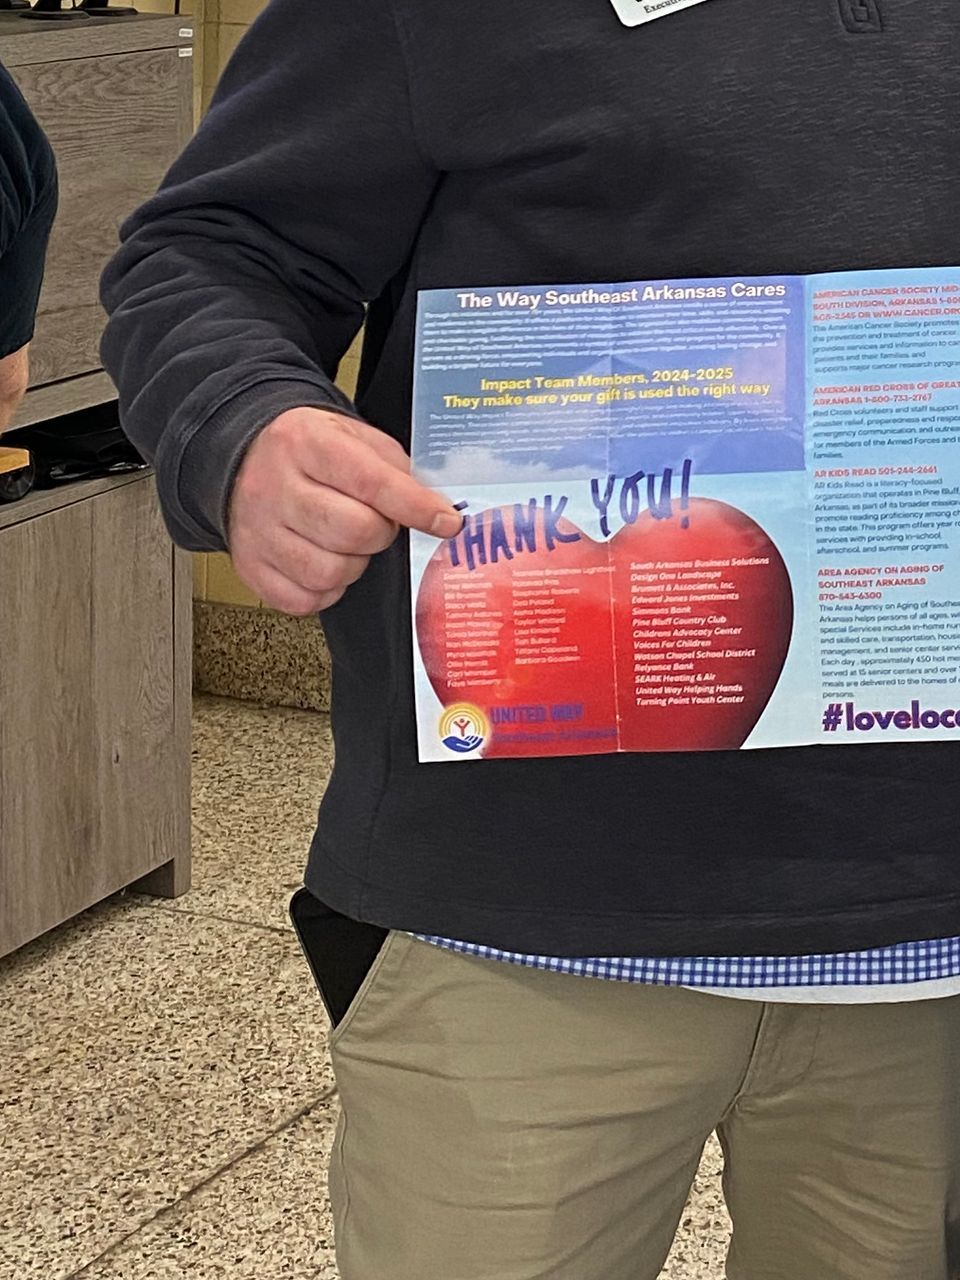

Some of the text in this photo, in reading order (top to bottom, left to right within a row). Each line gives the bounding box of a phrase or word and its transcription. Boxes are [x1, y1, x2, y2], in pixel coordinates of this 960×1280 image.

[457, 279, 785, 311] The Way Southeast Arkansas Cares
[813, 289, 859, 299] AMERICAN
[861, 287, 898, 297] CANCER
[901, 285, 939, 295] SOCIETY
[813, 301, 843, 310] SOUTH
[845, 299, 886, 310] DIVISION,
[889, 297, 937, 307] ARKANSAS
[481, 366, 733, 394] Impact Team Members, 2024-2025
[813, 385, 860, 395] AMERICAN
[863, 384, 880, 393] RED
[883, 383, 914, 392] CROSS
[917, 382, 928, 390] OF
[444, 382, 770, 411] They make sure your gift is used the right way
[813, 396, 862, 406] ARKANSAS
[829, 469, 849, 477] KIDS
[852, 468, 876, 476] READ
[591, 459, 692, 537] YOU!
[630, 556, 769, 570] South Arkansas Business Solutions
[631, 570, 721, 583] Design One Landscape
[818, 564, 944, 577] AREA AGENCY ON AGING OF
[673, 582, 719, 593] Associates,
[720, 581, 735, 589] Inc.
[819, 577, 926, 589] SOUTHEAST ARKANSAS
[632, 592, 739, 604] Edward Jones Investments
[632, 605, 691, 615] Simmons Bank
[633, 615, 727, 626] Pine Bluff Country Club
[633, 626, 742, 638] Childrens Advocacy Center
[634, 639, 711, 649] Voices For Children
[634, 649, 755, 661] Watson Chapel School District
[673, 662, 694, 670] Bank
[635, 674, 662, 683] SEARK
[663, 673, 695, 684] Heating
[703, 672, 716, 680] Air
[636, 684, 743, 695] United Way Helping Hands
[637, 695, 744, 708] Turning Point Youth Center
